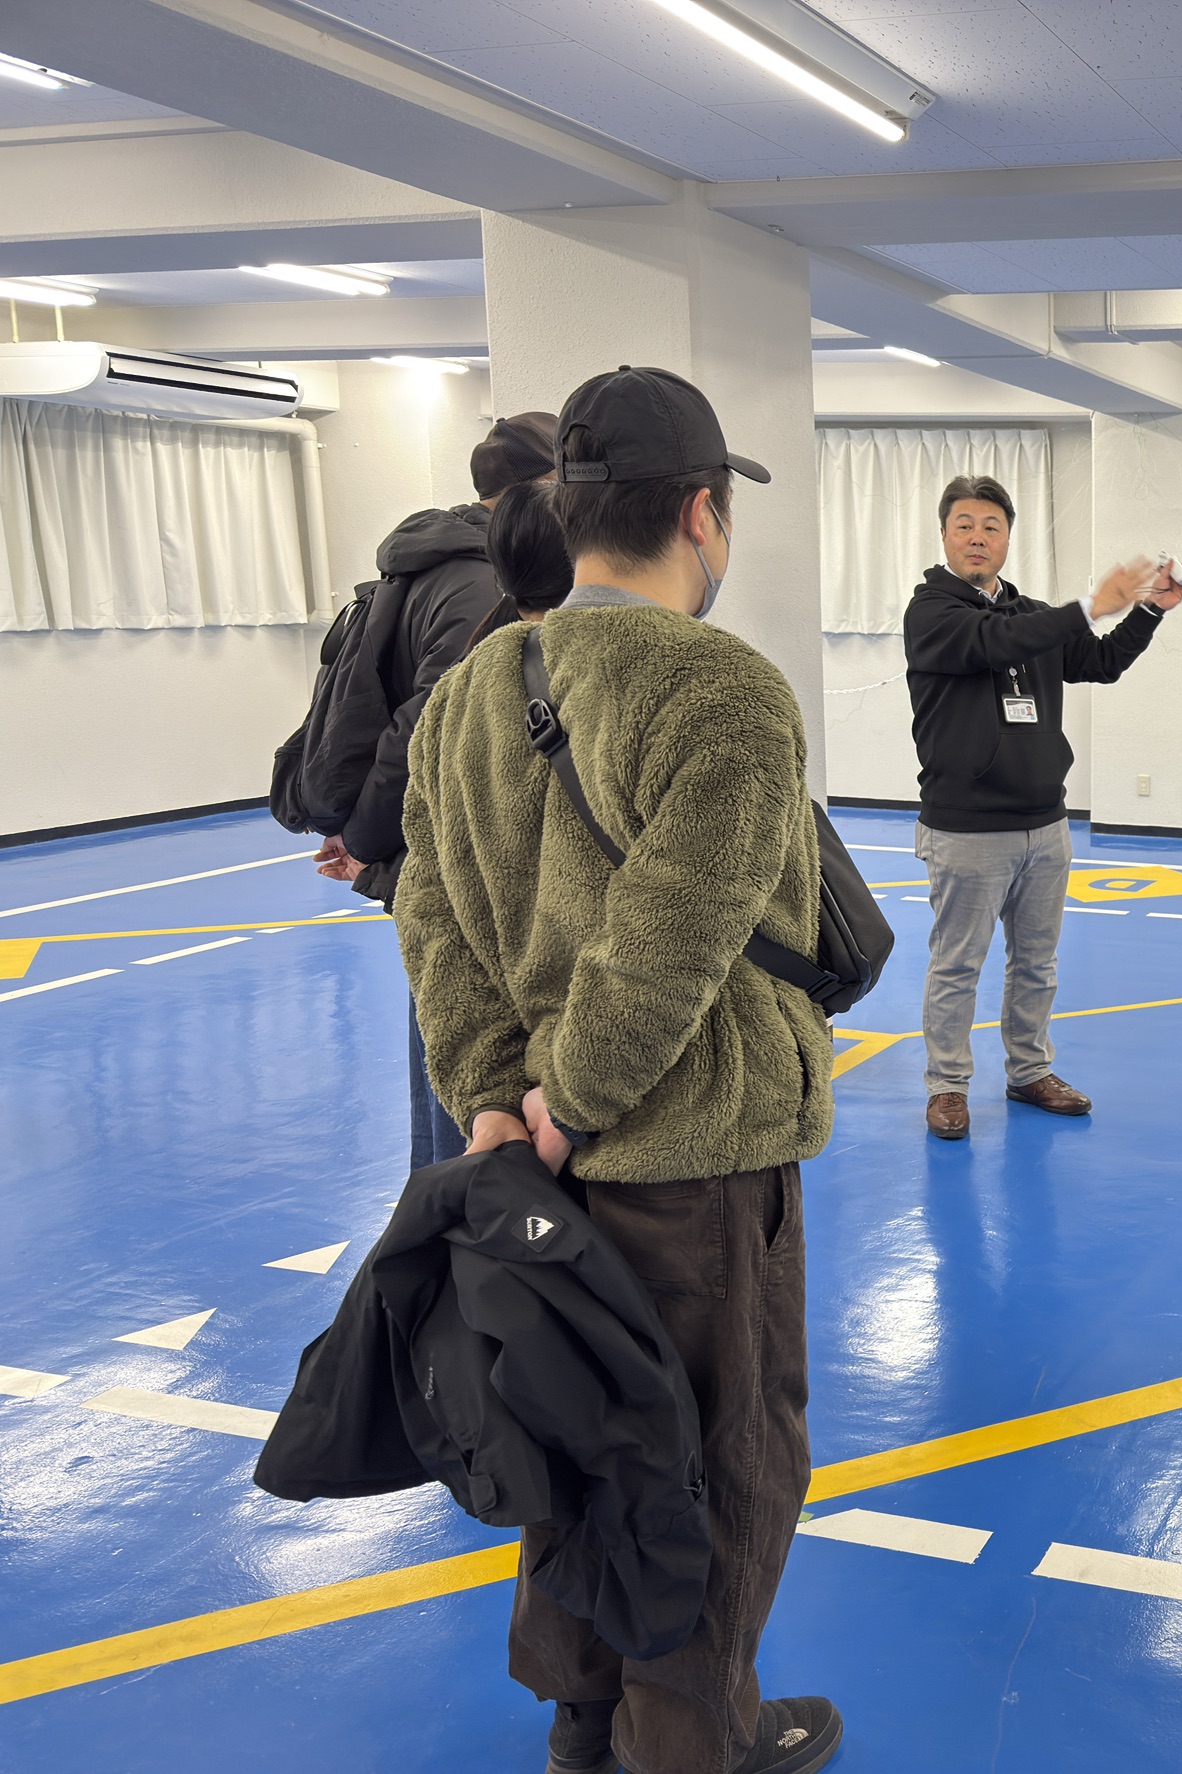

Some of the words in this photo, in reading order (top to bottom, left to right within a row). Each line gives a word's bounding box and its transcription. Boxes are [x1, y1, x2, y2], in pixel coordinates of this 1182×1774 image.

[1088, 878, 1158, 892] D
[777, 1733, 797, 1747] NORTH
[785, 1736, 802, 1749] FACE
